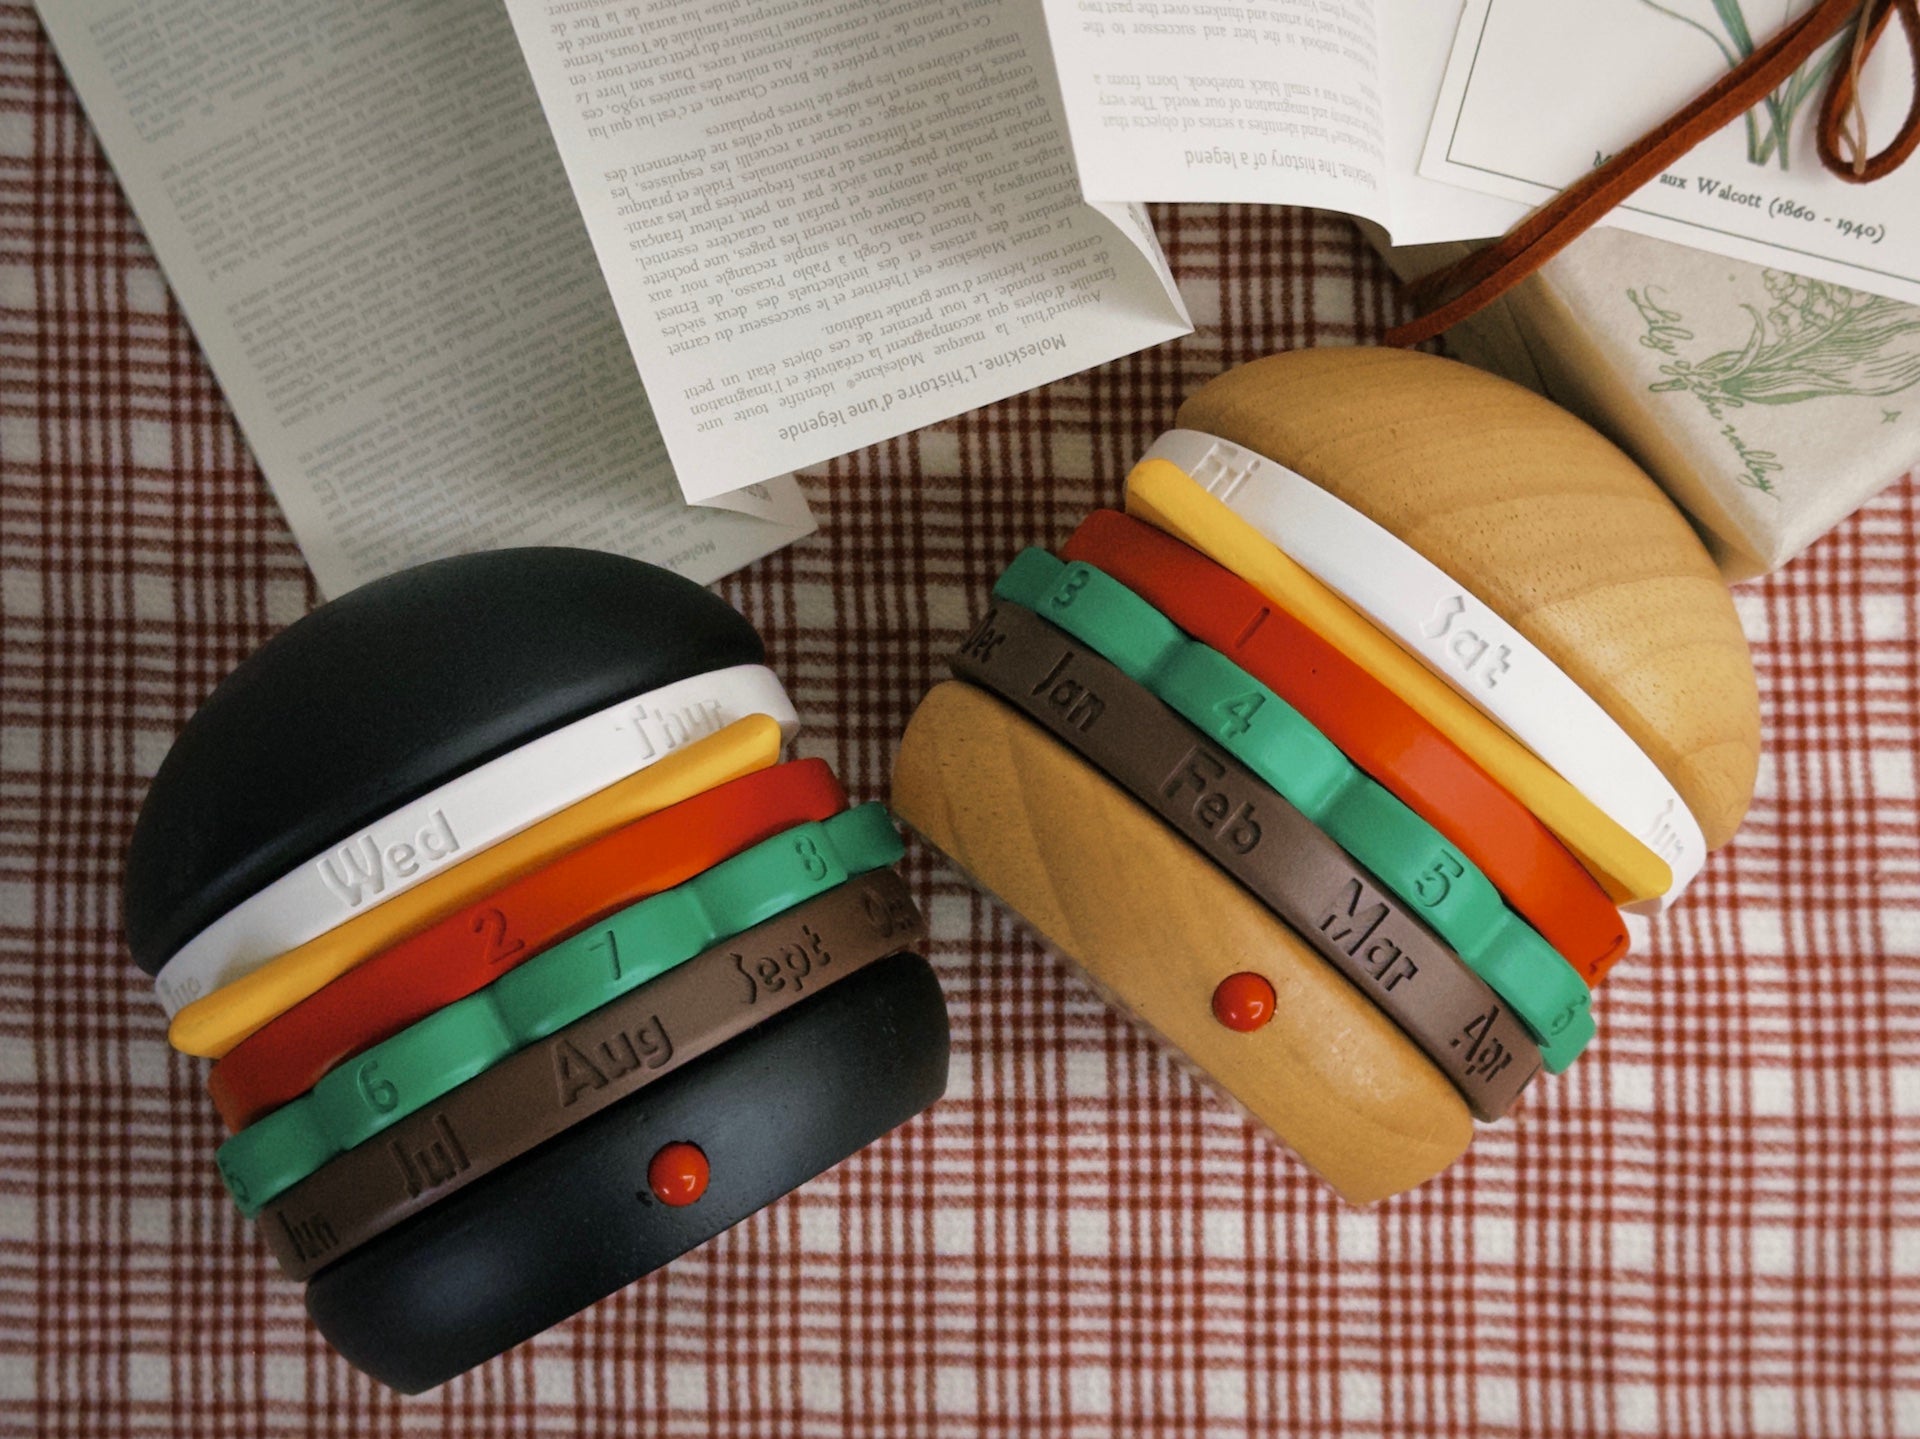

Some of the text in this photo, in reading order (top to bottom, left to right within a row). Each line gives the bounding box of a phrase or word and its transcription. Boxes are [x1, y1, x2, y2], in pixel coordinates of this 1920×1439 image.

[1082, 22, 1105, 39] the
[1111, 22, 1126, 36] to
[1132, 23, 1197, 37] successor
[1203, 25, 1227, 41] and
[1107, 75, 1142, 91] from
[1146, 75, 1181, 91] born
[1249, 79, 1281, 97] black
[1099, 90, 1127, 107] very
[1130, 96, 1158, 111] The
[1229, 98, 1241, 113] of
[580, 107, 604, 120] ces
[587, 114, 656, 142] lui qui lui
[1102, 116, 1129, 131] that
[1132, 115, 1179, 132] objects
[1182, 117, 1195, 133] of
[1199, 117, 1235, 130] series
[1184, 146, 1238, 169] legend
[1240, 152, 1249, 165] a
[1253, 153, 1268, 171] of
[1271, 149, 1317, 175] history
[1318, 160, 1338, 179] The
[976, 190, 988, 204] à
[1023, 176, 1081, 203] derniers
[930, 195, 972, 216] Bruce
[988, 202, 1008, 217] de
[1660, 171, 1688, 190] aux
[1696, 176, 1761, 210] Walcott
[1768, 197, 1816, 223] (1860
[1835, 218, 1887, 246] 1940)
[628, 183, 824, 253] par un petit relieur français
[929, 210, 983, 237] Vincent
[985, 218, 1011, 234] des
[1054, 216, 1073, 231] Le
[835, 232, 859, 247] Un
[897, 230, 923, 245] van
[929, 230, 978, 254] artistes
[1009, 223, 1052, 247] carnet
[782, 241, 830, 264] simple
[852, 240, 893, 264] Gogh
[935, 239, 1007, 270] Moleskine
[1060, 233, 1103, 257] carnet
[837, 254, 848, 269] à
[876, 255, 902, 271] des
[908, 248, 922, 263] et
[1091, 249, 1111, 265] de
[714, 257, 777, 285] rectangle
[791, 259, 832, 281] Pablo
[912, 263, 933, 280] est
[974, 260, 1026, 285] héritier
[1050, 257, 1087, 278] notre
[679, 278, 708, 296] noir
[787, 266, 870, 302] intellectuels
[1068, 266, 1118, 292] famille
[648, 288, 673, 302] aux
[706, 292, 725, 307] de
[755, 294, 781, 309] des
[815, 297, 830, 312] le
[832, 292, 846, 306] et
[884, 288, 932, 317] grande
[971, 291, 990, 306] Le
[654, 300, 700, 322] Ernest
[713, 304, 750, 322] deux
[737, 303, 812, 333] successeur
[938, 299, 967, 318] tout
[986, 299, 1010, 323] qui
[660, 316, 706, 338] siècles
[878, 306, 933, 336] premier
[994, 322, 1010, 337] la
[714, 327, 736, 342] du
[856, 330, 875, 345] de
[884, 312, 983, 355] accompagnent
[932, 330, 986, 356] marque
[666, 334, 711, 357] carnet
[827, 337, 851, 353] ces
[867, 346, 883, 360] la
[781, 346, 823, 368] objets
[746, 362, 778, 381] était
[802, 352, 865, 384] créativité
[683, 378, 715, 401] petit
[720, 373, 740, 387] un
[784, 373, 799, 387] et
[777, 381, 836, 409] identifie
[732, 402, 769, 422] toute
[846, 392, 896, 418] d'une
[695, 417, 724, 433] une
[777, 408, 846, 441] légende
[1720, 424, 1784, 503] valley
[1189, 440, 1262, 504] Fri
[1418, 594, 1513, 690] Sat
[1049, 568, 1090, 610] 3
[1212, 691, 1267, 741] 4
[1414, 847, 1467, 909] 5
[315, 807, 461, 908] Wed
[1026, 650, 1107, 735] Jan
[1178, 744, 1263, 856] Feb
[1318, 876, 1421, 993] Mar
[1447, 1002, 1514, 1085] Apr
[471, 904, 527, 967] 2
[357, 1059, 400, 1118] 6
[587, 930, 623, 981] 7
[793, 834, 829, 883] 8
[276, 1209, 341, 1264] Jun
[386, 1111, 472, 1200] Jul
[548, 1014, 676, 1109] Aug
[729, 924, 833, 1006] Sept
